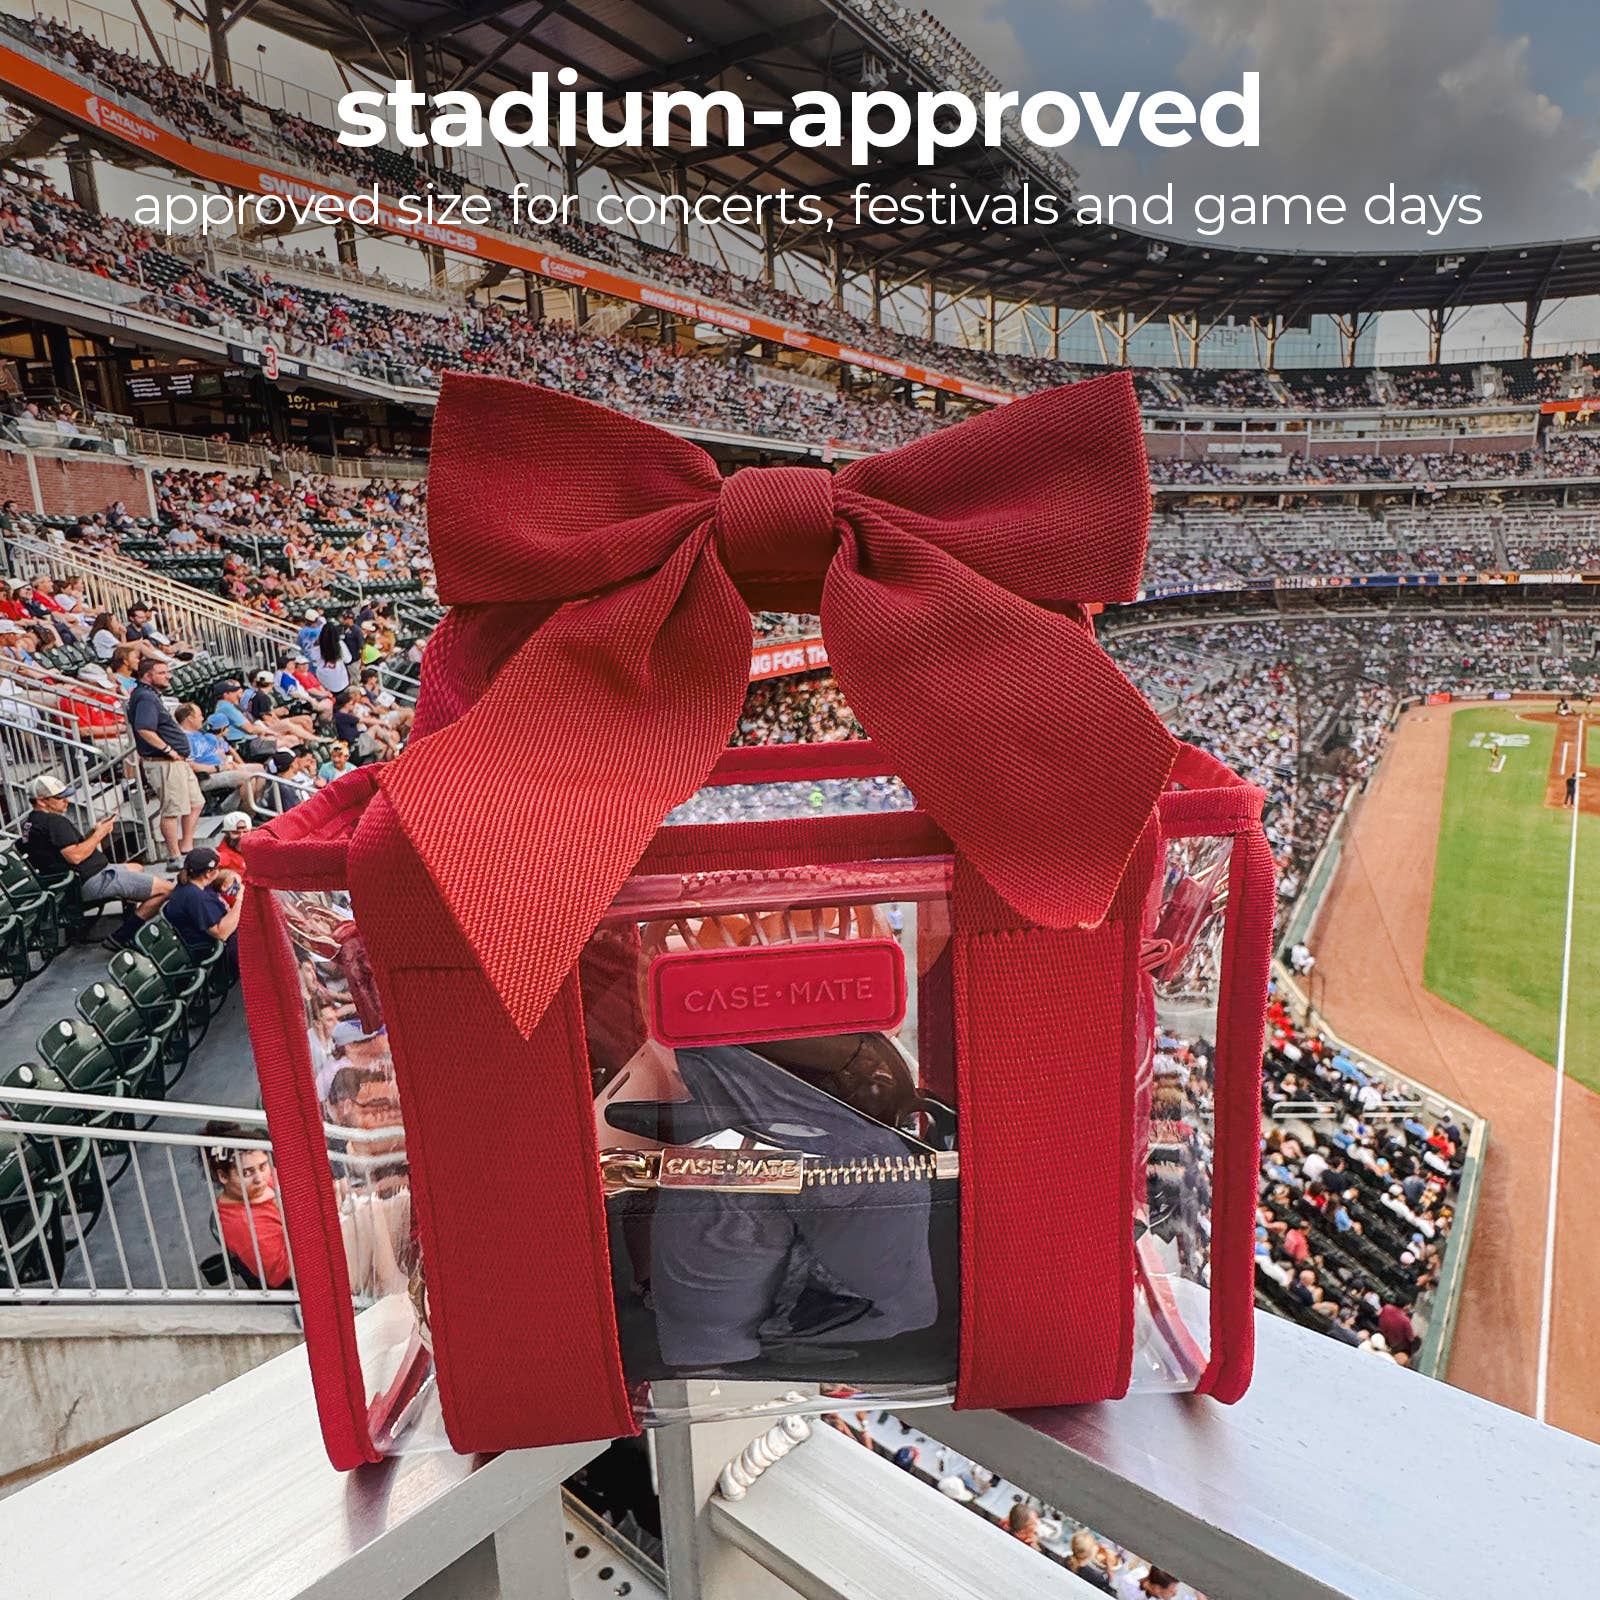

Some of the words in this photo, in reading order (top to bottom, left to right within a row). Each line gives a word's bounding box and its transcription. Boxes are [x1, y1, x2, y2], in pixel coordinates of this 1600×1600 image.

[101, 105, 159, 141] CATALYST
[413, 221, 478, 251] FENCES
[262, 344, 279, 380] 3
[772, 648, 806, 671] FOR
